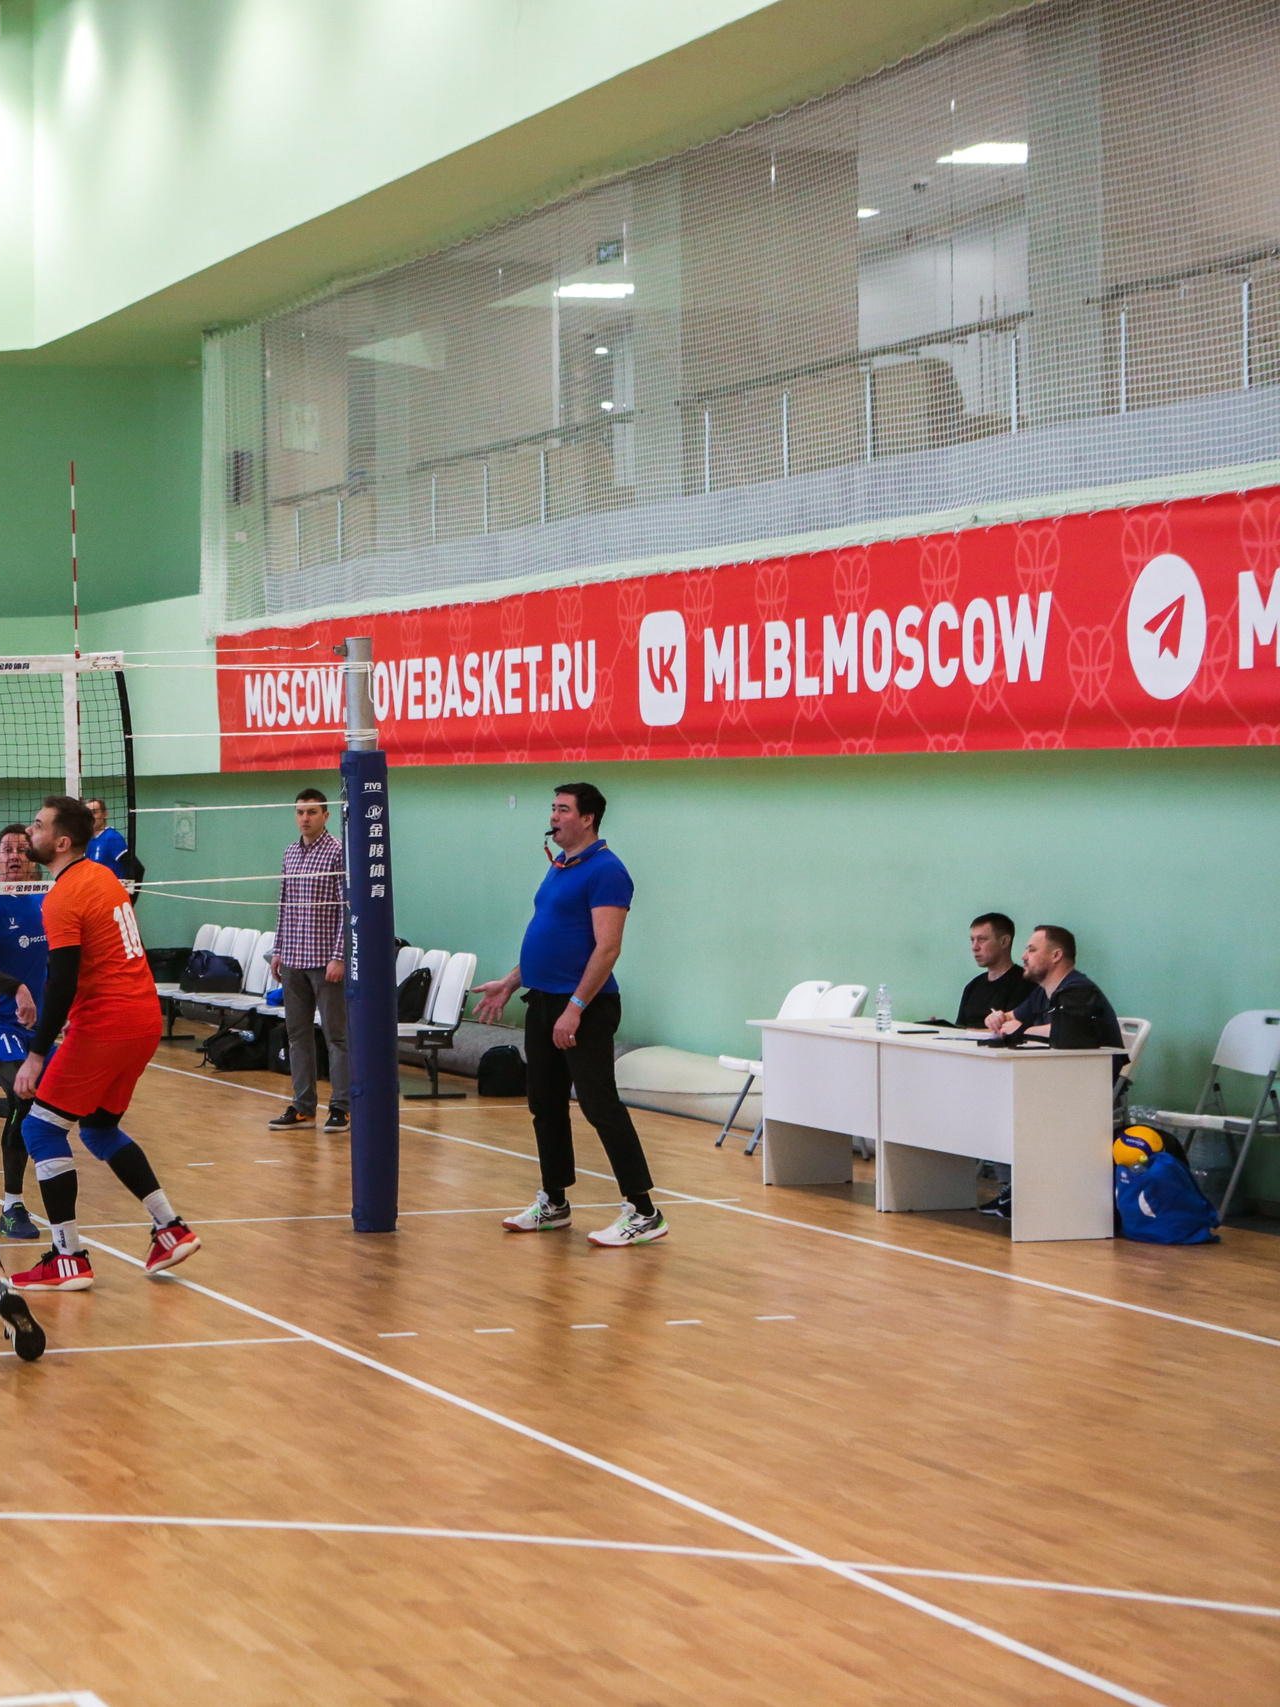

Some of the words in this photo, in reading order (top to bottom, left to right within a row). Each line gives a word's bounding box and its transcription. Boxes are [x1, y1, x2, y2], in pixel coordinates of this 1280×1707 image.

[245, 639, 596, 728] MOSCOW.OVEBASKET.RU
[703, 591, 1052, 702] MLBLMOSCOW
[364, 782, 382, 790] FIVB
[368, 823, 385, 898] 金陵体育
[30, 935, 46, 943] РОССЕ
